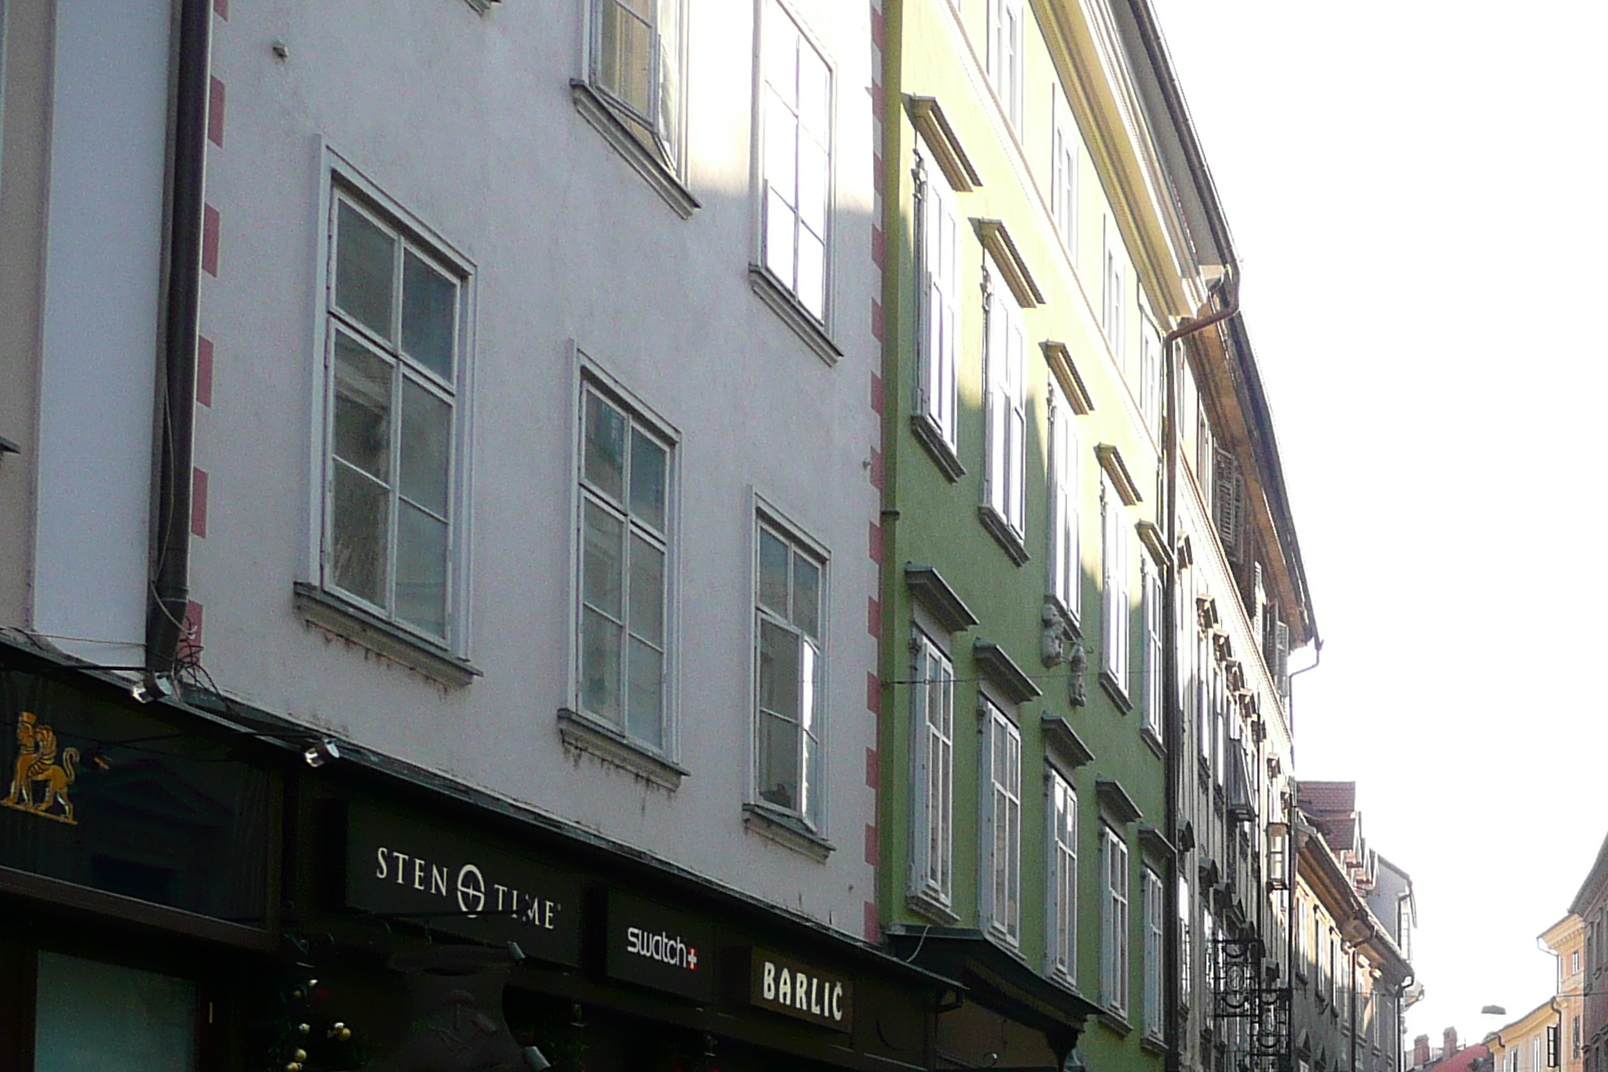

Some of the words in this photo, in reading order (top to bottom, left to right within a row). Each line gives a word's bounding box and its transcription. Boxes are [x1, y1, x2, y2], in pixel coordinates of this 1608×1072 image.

[376, 847, 449, 897] STEN
[494, 884, 555, 930] TIME
[627, 926, 687, 969] swatch
[763, 961, 843, 1021] BARLIČ
